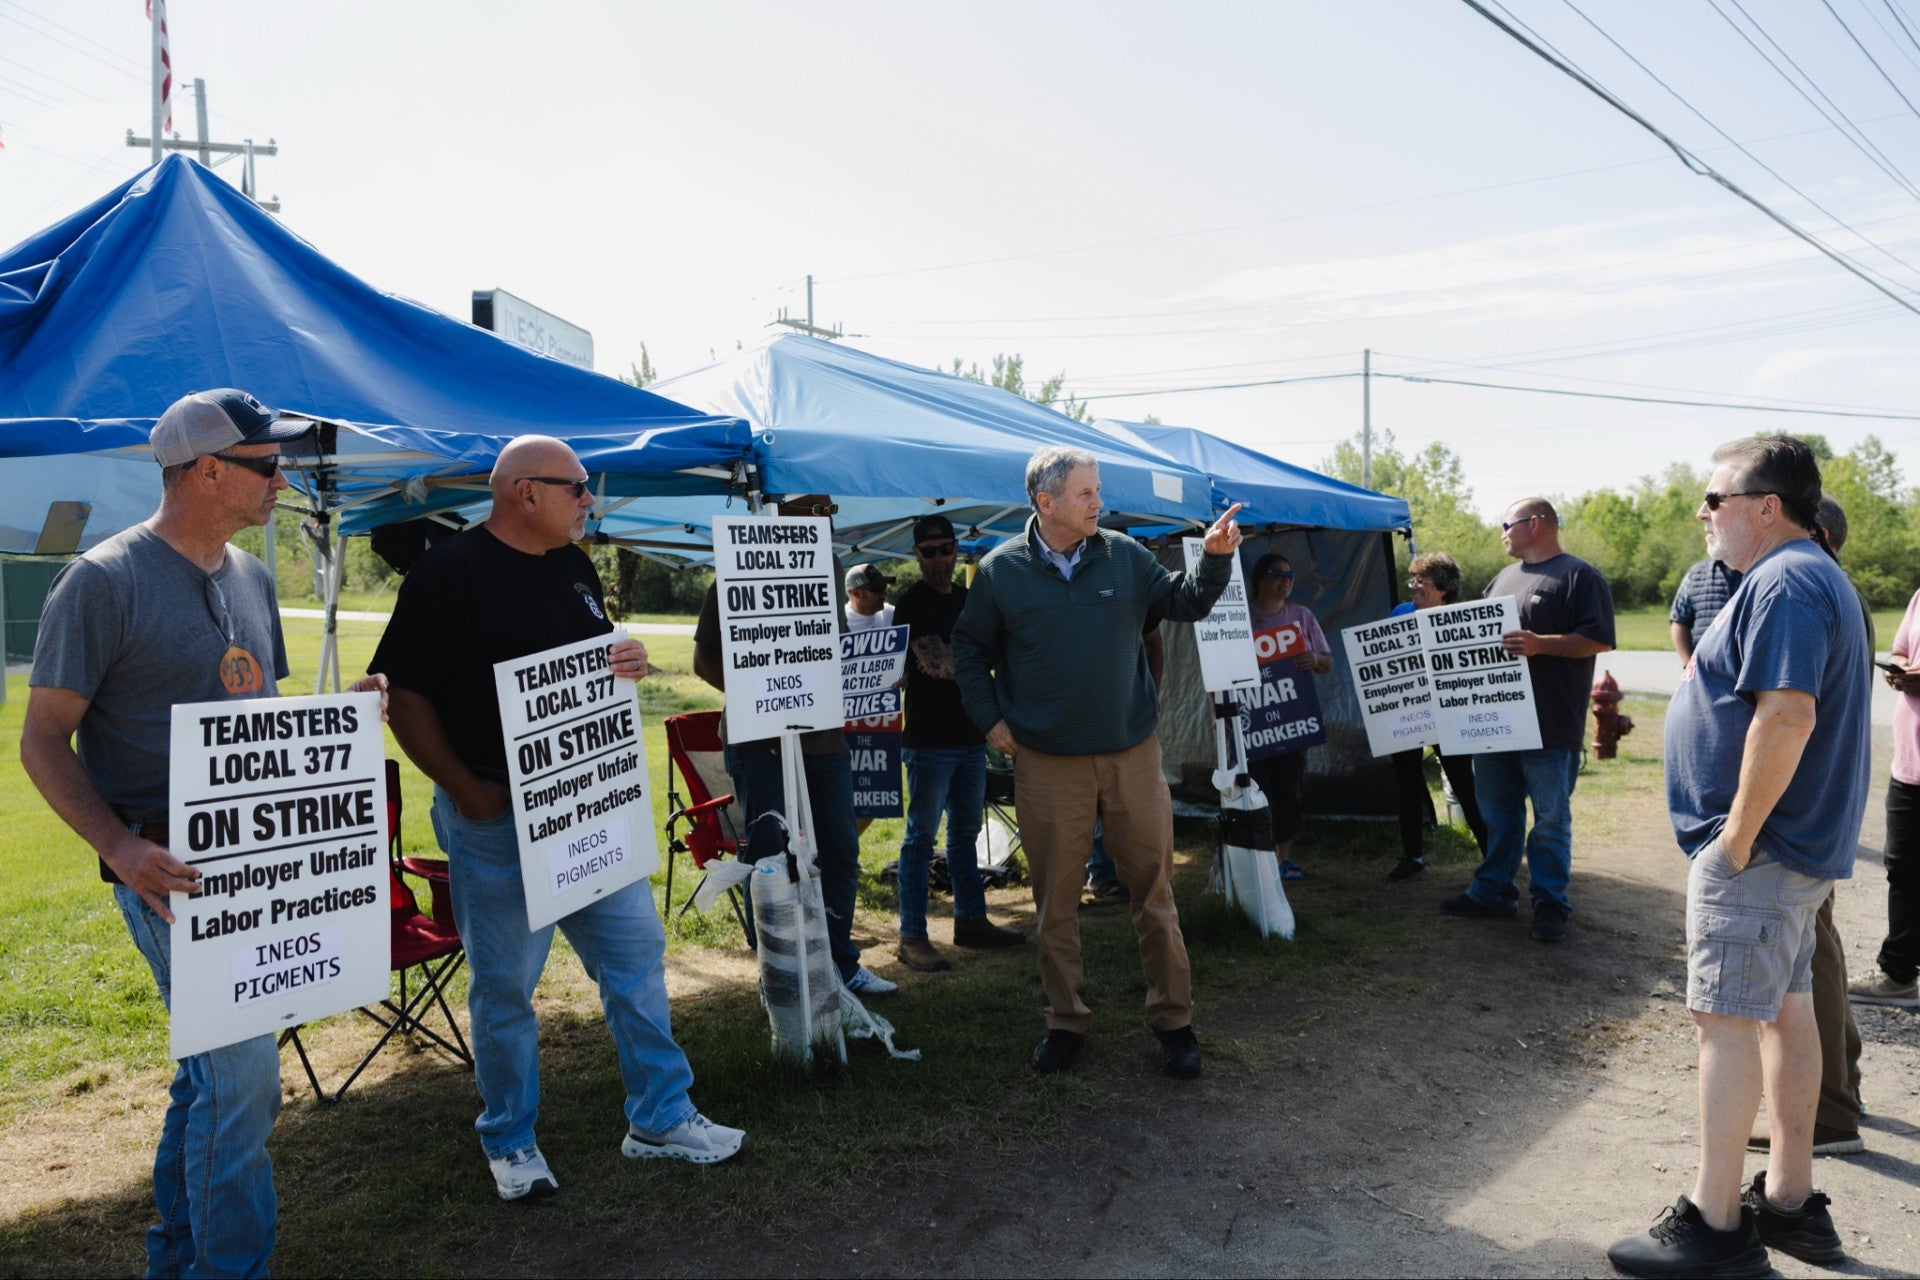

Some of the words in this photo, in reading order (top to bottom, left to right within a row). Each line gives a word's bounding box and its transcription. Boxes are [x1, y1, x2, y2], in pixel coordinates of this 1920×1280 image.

[727, 525, 818, 545] TEAMSTERS
[736, 550, 784, 570] LOCAL
[788, 551, 815, 569] 377
[727, 585, 756, 612] ON
[762, 583, 829, 610] STRIKE
[1218, 584, 1244, 602] RIKE
[1228, 609, 1247, 621] Unfair
[1428, 603, 1505, 628] TEAMSTERS
[729, 623, 791, 644] Employer
[794, 619, 832, 637] Unfair
[1200, 628, 1218, 642] Labor
[1220, 628, 1250, 641] Practices
[1354, 617, 1418, 644] TEAMSTE
[1434, 626, 1475, 644] LOCAL
[1479, 622, 1503, 638] 377
[733, 651, 770, 669] Labor
[774, 646, 833, 665] Practices
[1362, 637, 1404, 657] LOCAL
[861, 658, 895, 674] LABOR
[1358, 661, 1383, 682] ON
[1386, 653, 1425, 676] STRI
[1431, 652, 1454, 671] ON
[766, 675, 802, 692] INEOS
[842, 674, 883, 691] ACTICE
[1260, 666, 1273, 680] HE
[1434, 675, 1484, 692] Employer
[1487, 670, 1522, 685] Unfair
[525, 685, 582, 723] LOCAL
[585, 674, 615, 703] 377
[1236, 677, 1298, 711] WAR
[1363, 681, 1415, 700] Employer
[1439, 694, 1468, 709] Labor
[1472, 689, 1525, 706] Practices
[756, 693, 814, 714] PIGMENTS
[843, 693, 880, 718] RIKE
[1368, 700, 1400, 715] Labor
[1403, 691, 1432, 708] Pract
[200, 706, 358, 747] TEAMSTERS
[1265, 710, 1281, 723] ON
[1400, 710, 1431, 723] INEOS
[1468, 712, 1499, 724] INEOS
[856, 735, 872, 746] THE
[1392, 721, 1437, 738] PIGMENT
[1460, 725, 1512, 739] PIGMENTS
[518, 736, 553, 775] ON
[558, 708, 634, 761] STRIKE
[209, 748, 296, 786] LOCAL
[304, 743, 352, 774] 377
[523, 771, 594, 812] Employer
[597, 751, 638, 782] Unfair
[858, 776, 871, 787] ON
[853, 791, 899, 806] RKERS
[188, 807, 240, 852] ON
[253, 790, 374, 841] STRIKE
[529, 810, 573, 843] Labor
[576, 783, 642, 823] Practices
[567, 829, 608, 858] INEOS
[310, 843, 377, 876] Unfair
[556, 847, 623, 889] PIGMENTS
[191, 908, 263, 942] Labor
[271, 885, 377, 925] Practices
[255, 932, 321, 967] INEOS
[234, 957, 341, 1003] PIGMENTS
